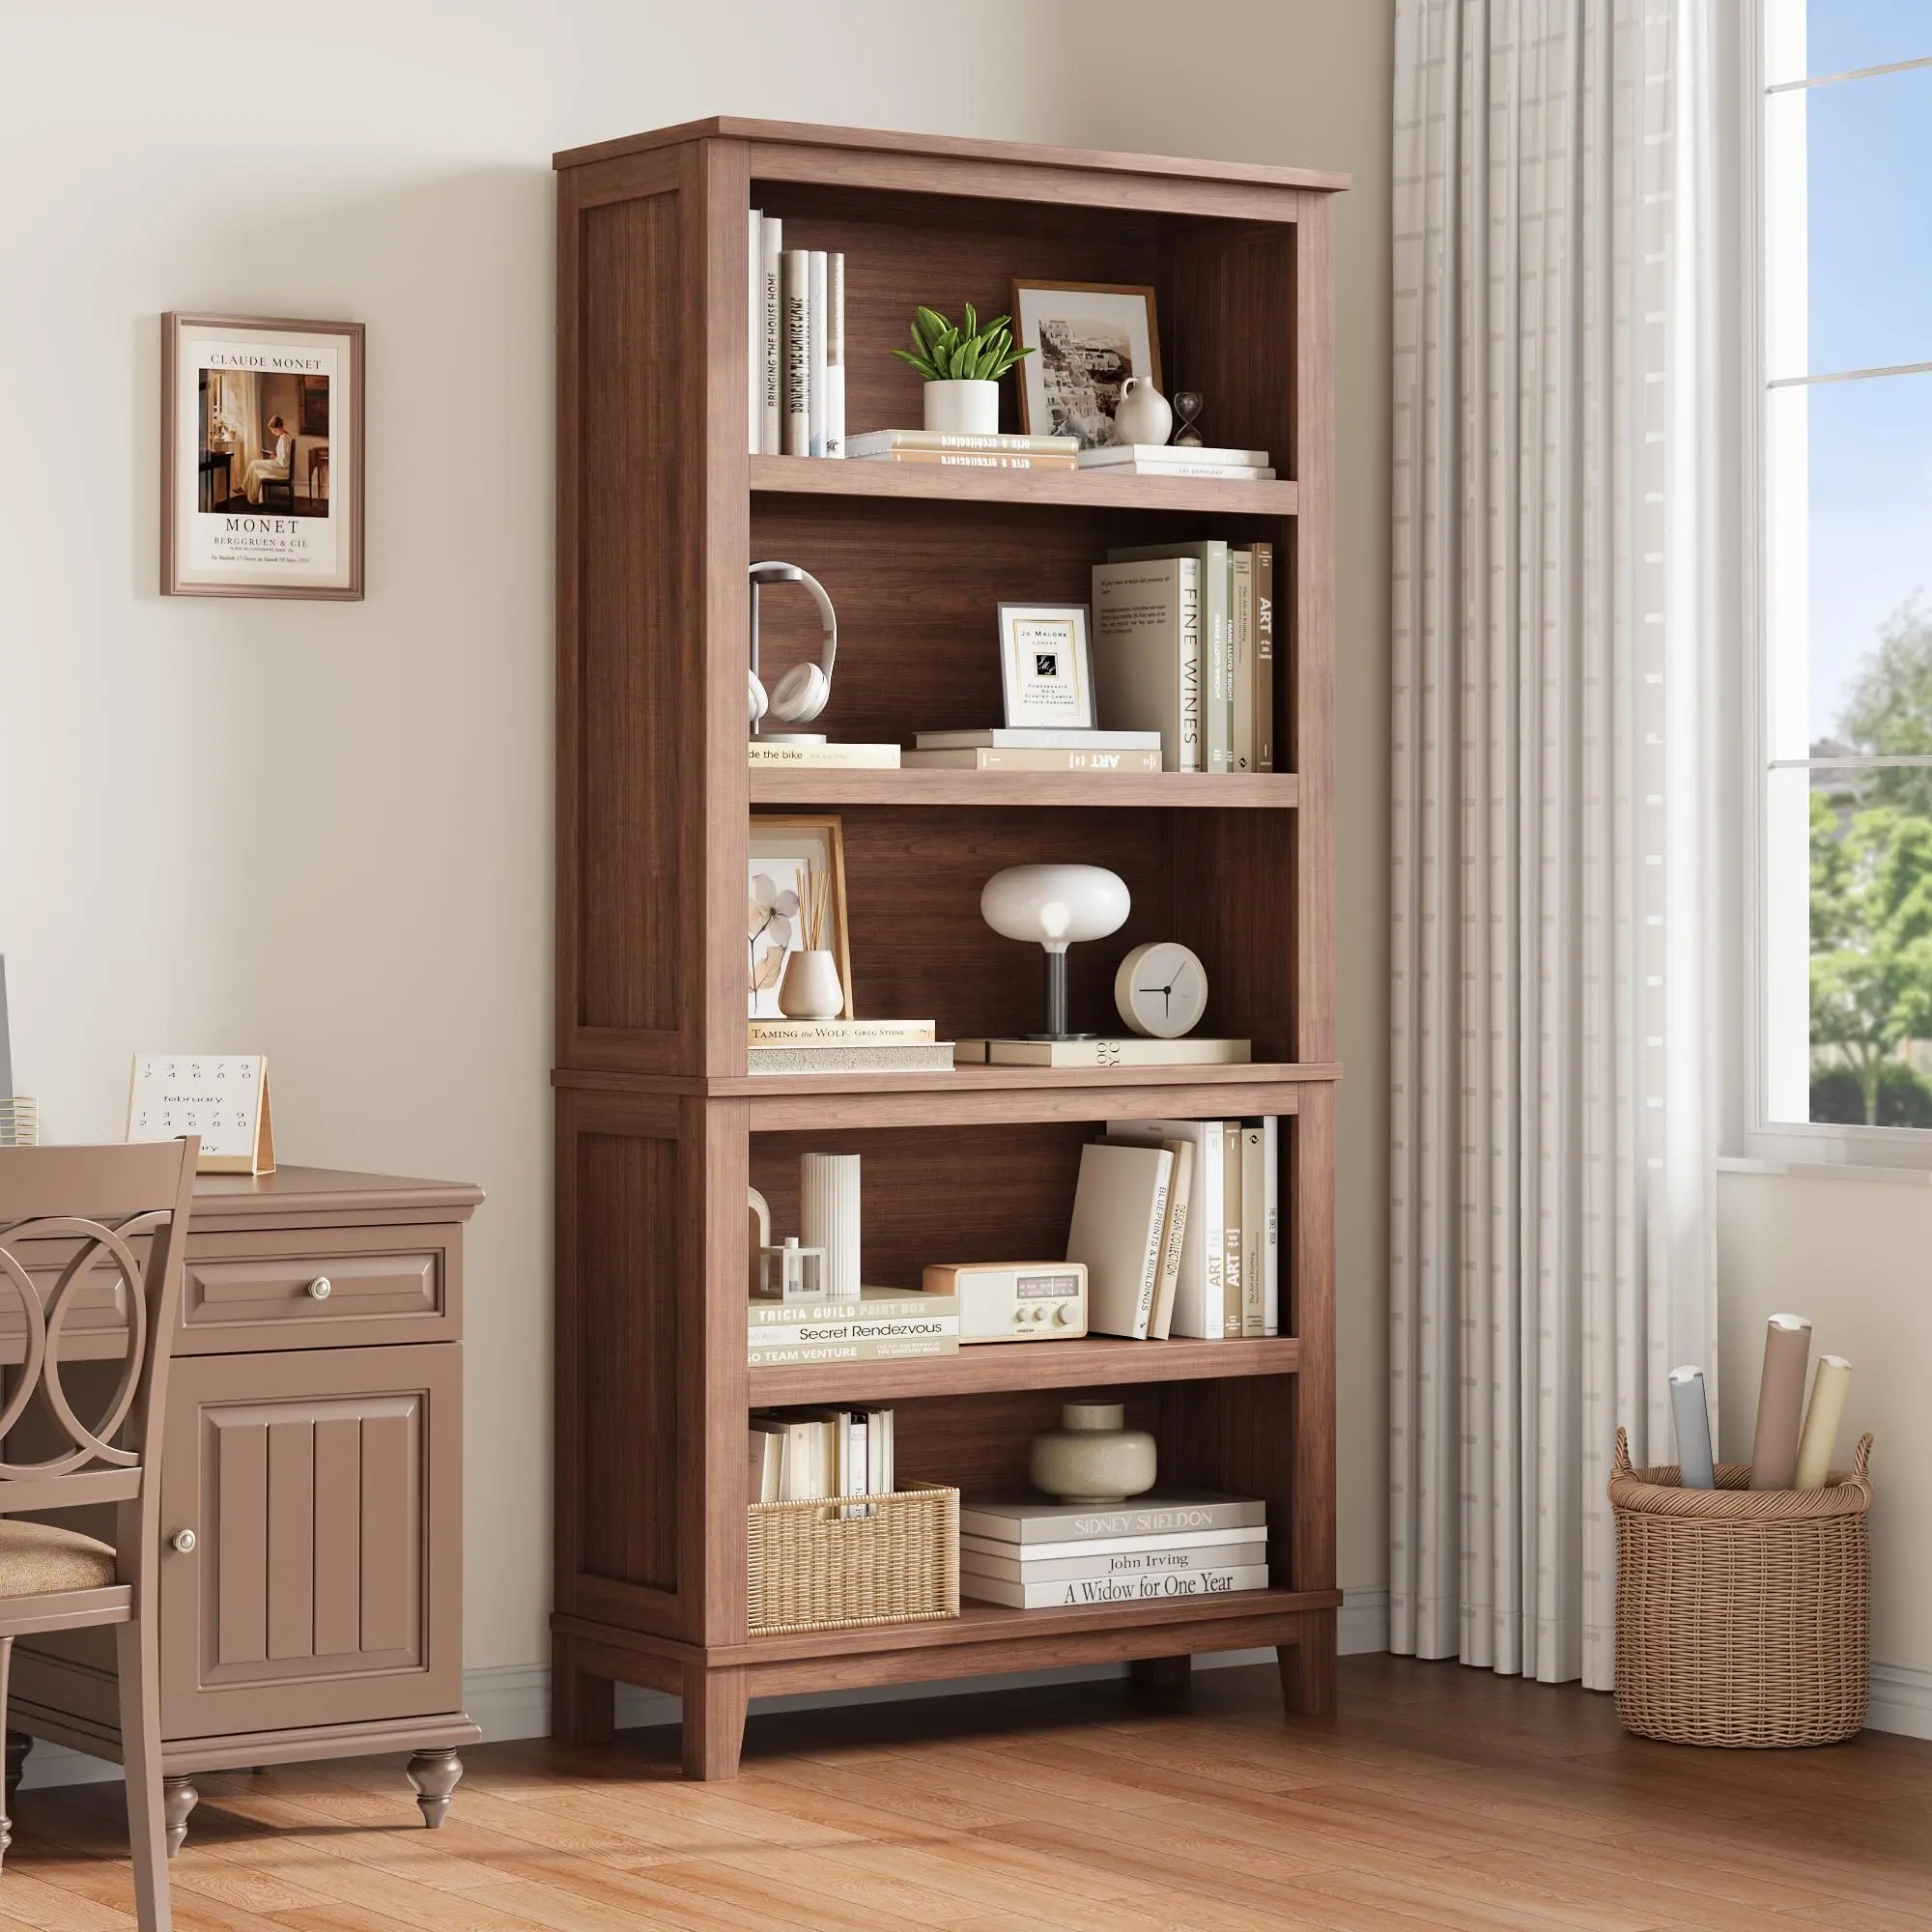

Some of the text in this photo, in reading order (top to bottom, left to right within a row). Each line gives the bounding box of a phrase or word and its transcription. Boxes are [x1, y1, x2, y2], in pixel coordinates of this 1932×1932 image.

[767, 272, 777, 407] BRINGING THE HOUSE HOME
[211, 355, 322, 370] CLAUDE MONET
[226, 518, 298, 533] MONET
[1184, 588, 1197, 645] FINE
[1260, 597, 1271, 634] ART
[1184, 658, 1197, 744] WINES
[763, 750, 779, 758] the
[781, 751, 803, 759] bike
[1090, 753, 1120, 768] ART
[752, 1028, 798, 1038] TAMING
[815, 1028, 847, 1037] WOLF
[1151, 1186, 1166, 1247] BLUEPRINTS
[1166, 1204, 1186, 1276] DESIGN COLLECTION
[1208, 1253, 1221, 1287] ART
[1226, 1252, 1240, 1287] ART
[1141, 1259, 1155, 1311] BUILDINGS
[758, 1305, 855, 1322] TRICIA GUILD
[800, 1322, 942, 1341] Secret Rendezvous
[765, 1350, 799, 1362] TEAM
[803, 1347, 858, 1359] VENTURE
[1074, 1510, 1212, 1535] SIDNEY SHELDON
[1108, 1553, 1188, 1573] John Irving
[1064, 1572, 1234, 1604] A Widow for One Year
